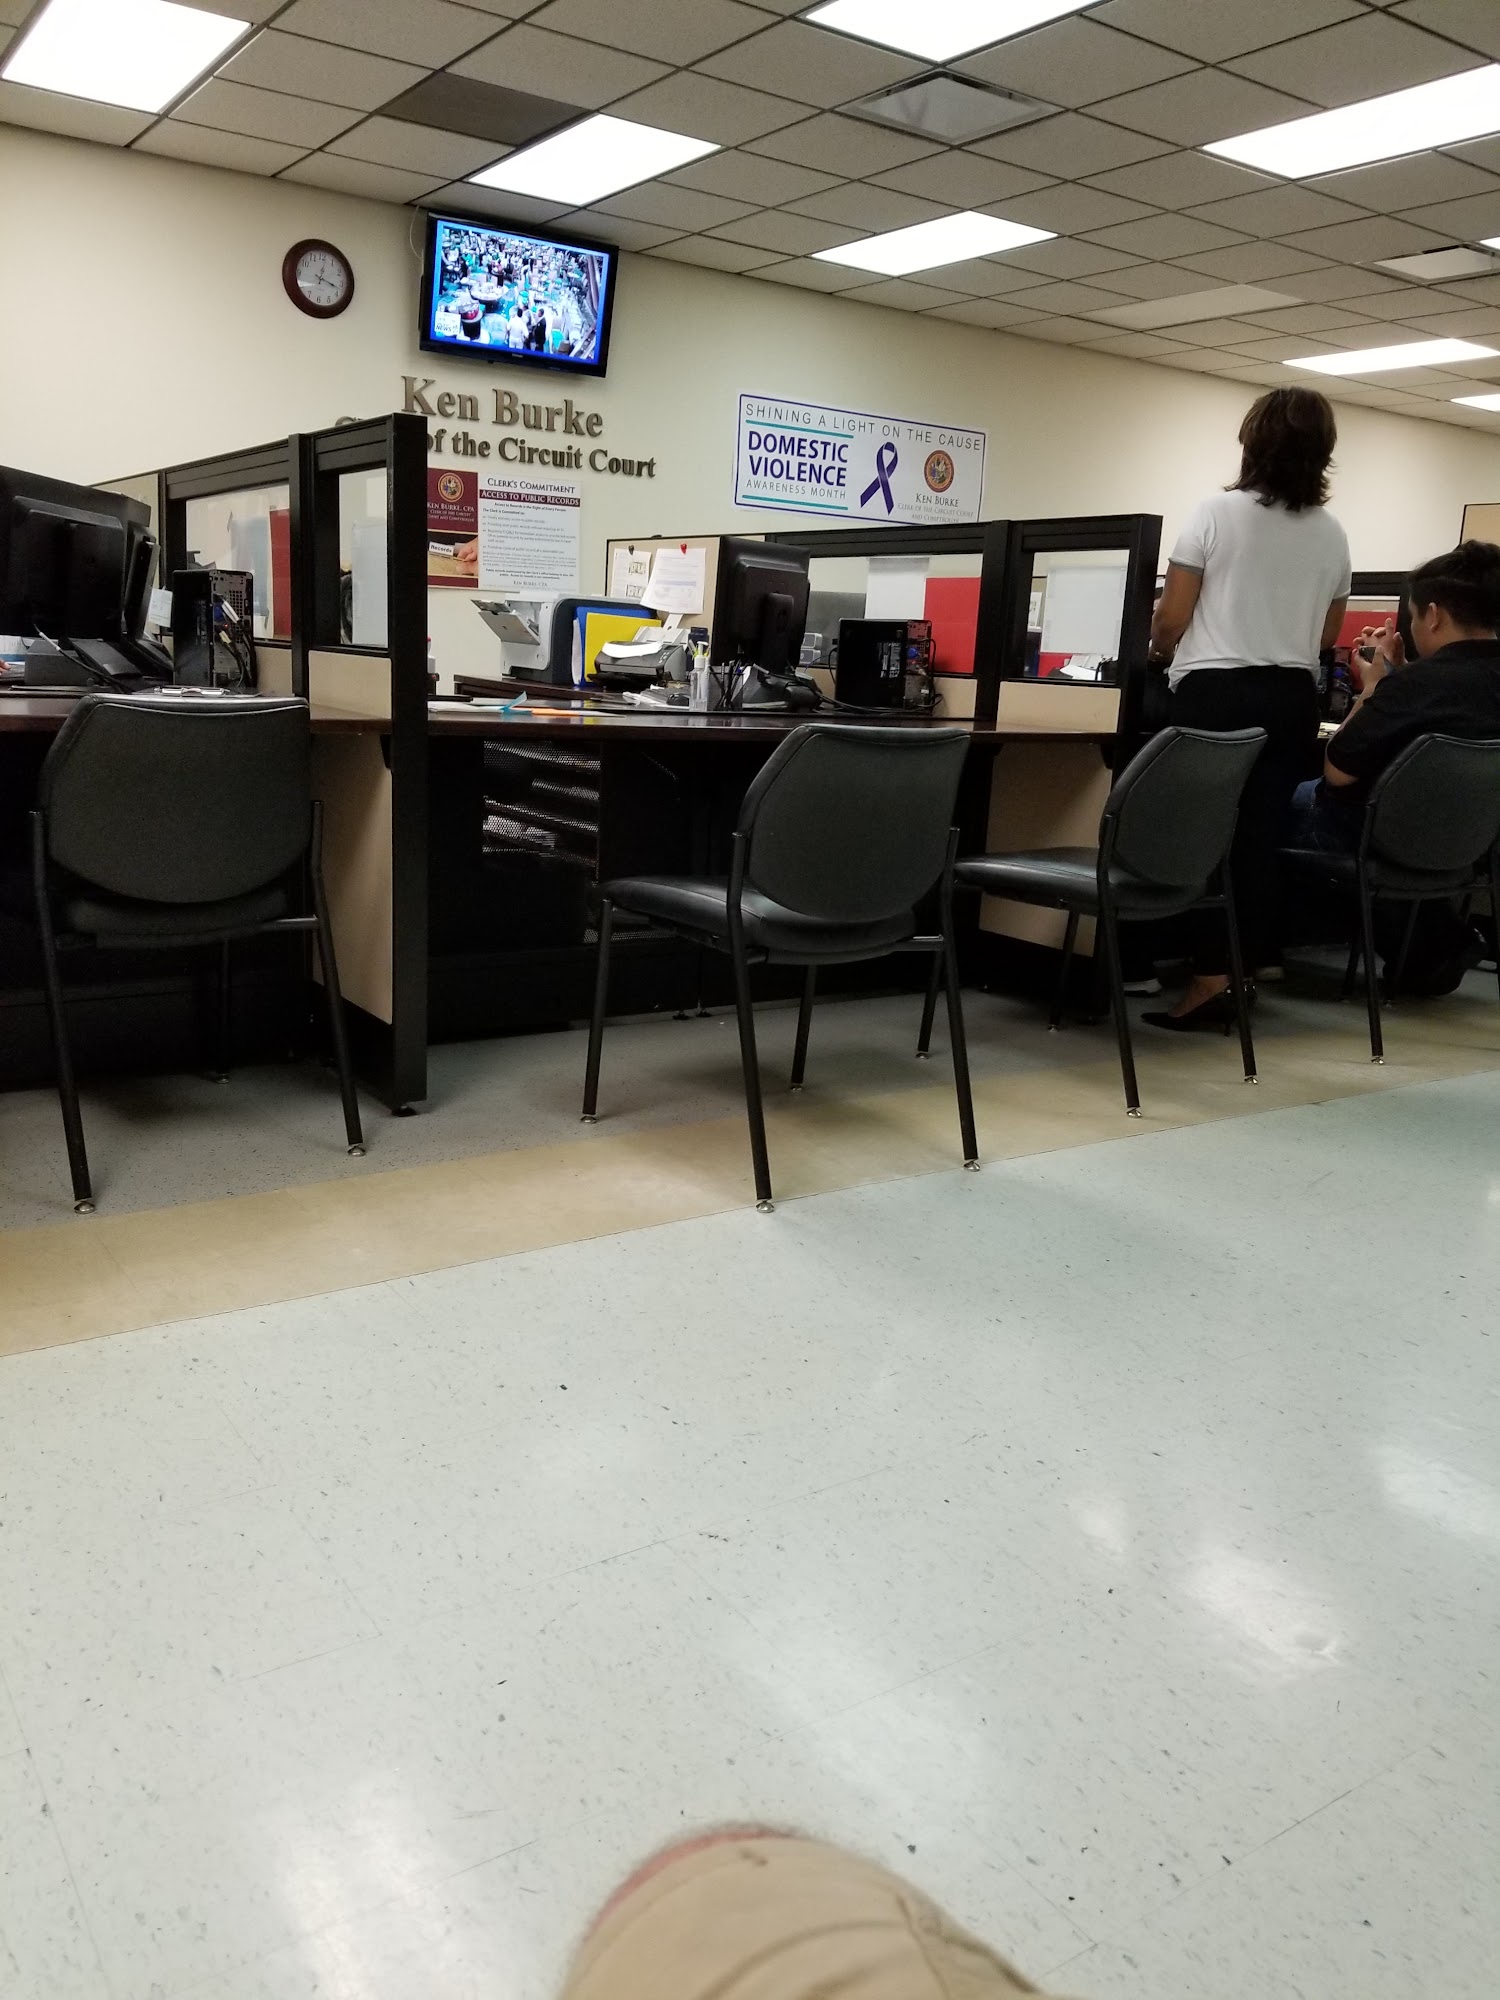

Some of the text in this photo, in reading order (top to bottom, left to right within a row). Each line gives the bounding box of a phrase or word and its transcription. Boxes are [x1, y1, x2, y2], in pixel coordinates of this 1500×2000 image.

[401, 375, 603, 438] Ken Burke
[746, 403, 982, 452] SHINING A LIGHT ON THE CAUSE
[451, 431, 491, 458] the
[498, 436, 583, 470] Circuit
[588, 448, 657, 479] Court
[748, 430, 849, 463] DOMESTIC
[749, 454, 848, 487] VIOLENCE
[481, 490, 580, 506] ACCESS TO PUBLIC RECORDS
[487, 477, 576, 494] CLERK'S COMMITMENT
[746, 479, 847, 500] AWARENESS MONTH
[915, 493, 960, 508] KEN BURKE
[430, 545, 452, 553] Records
